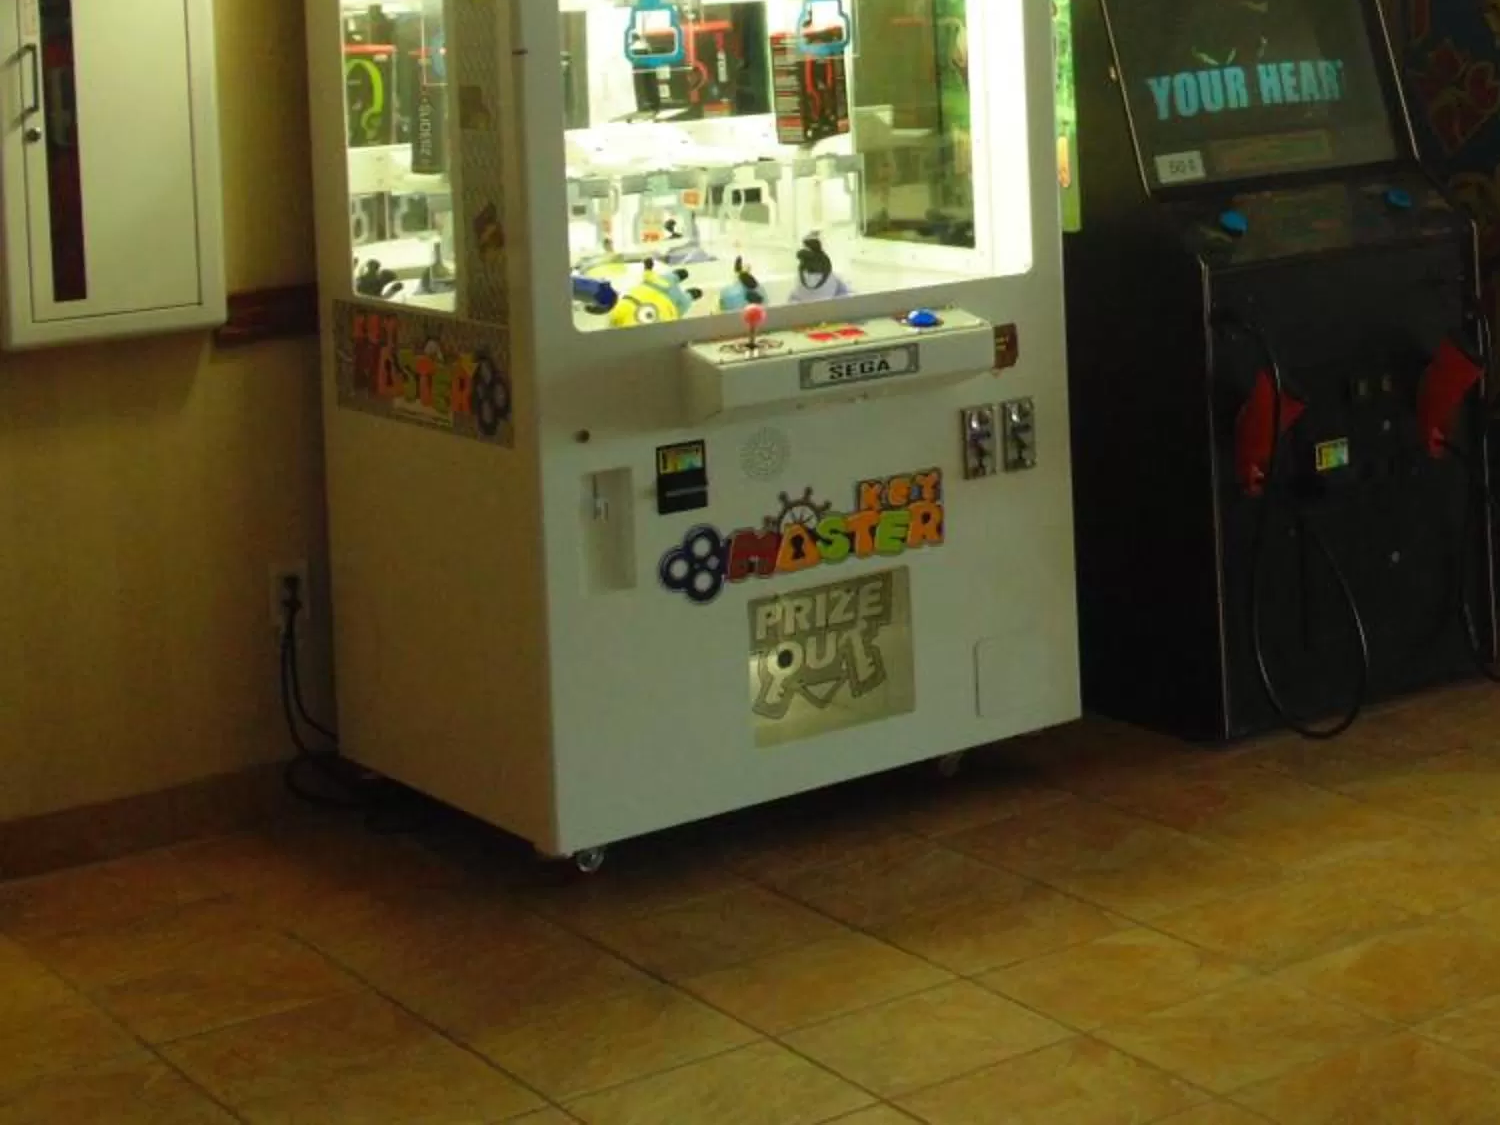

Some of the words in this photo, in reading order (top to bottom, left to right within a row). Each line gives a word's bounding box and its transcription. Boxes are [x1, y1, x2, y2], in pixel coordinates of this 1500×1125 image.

[1147, 66, 1250, 121] YOUR
[1256, 59, 1344, 107] HEAR
[353, 337, 475, 415] MASTER
[828, 357, 891, 381] SEGA
[856, 468, 942, 512] KEY
[724, 497, 945, 583] MASTER
[754, 579, 885, 642] PRIZE
[763, 617, 880, 706] OUT
